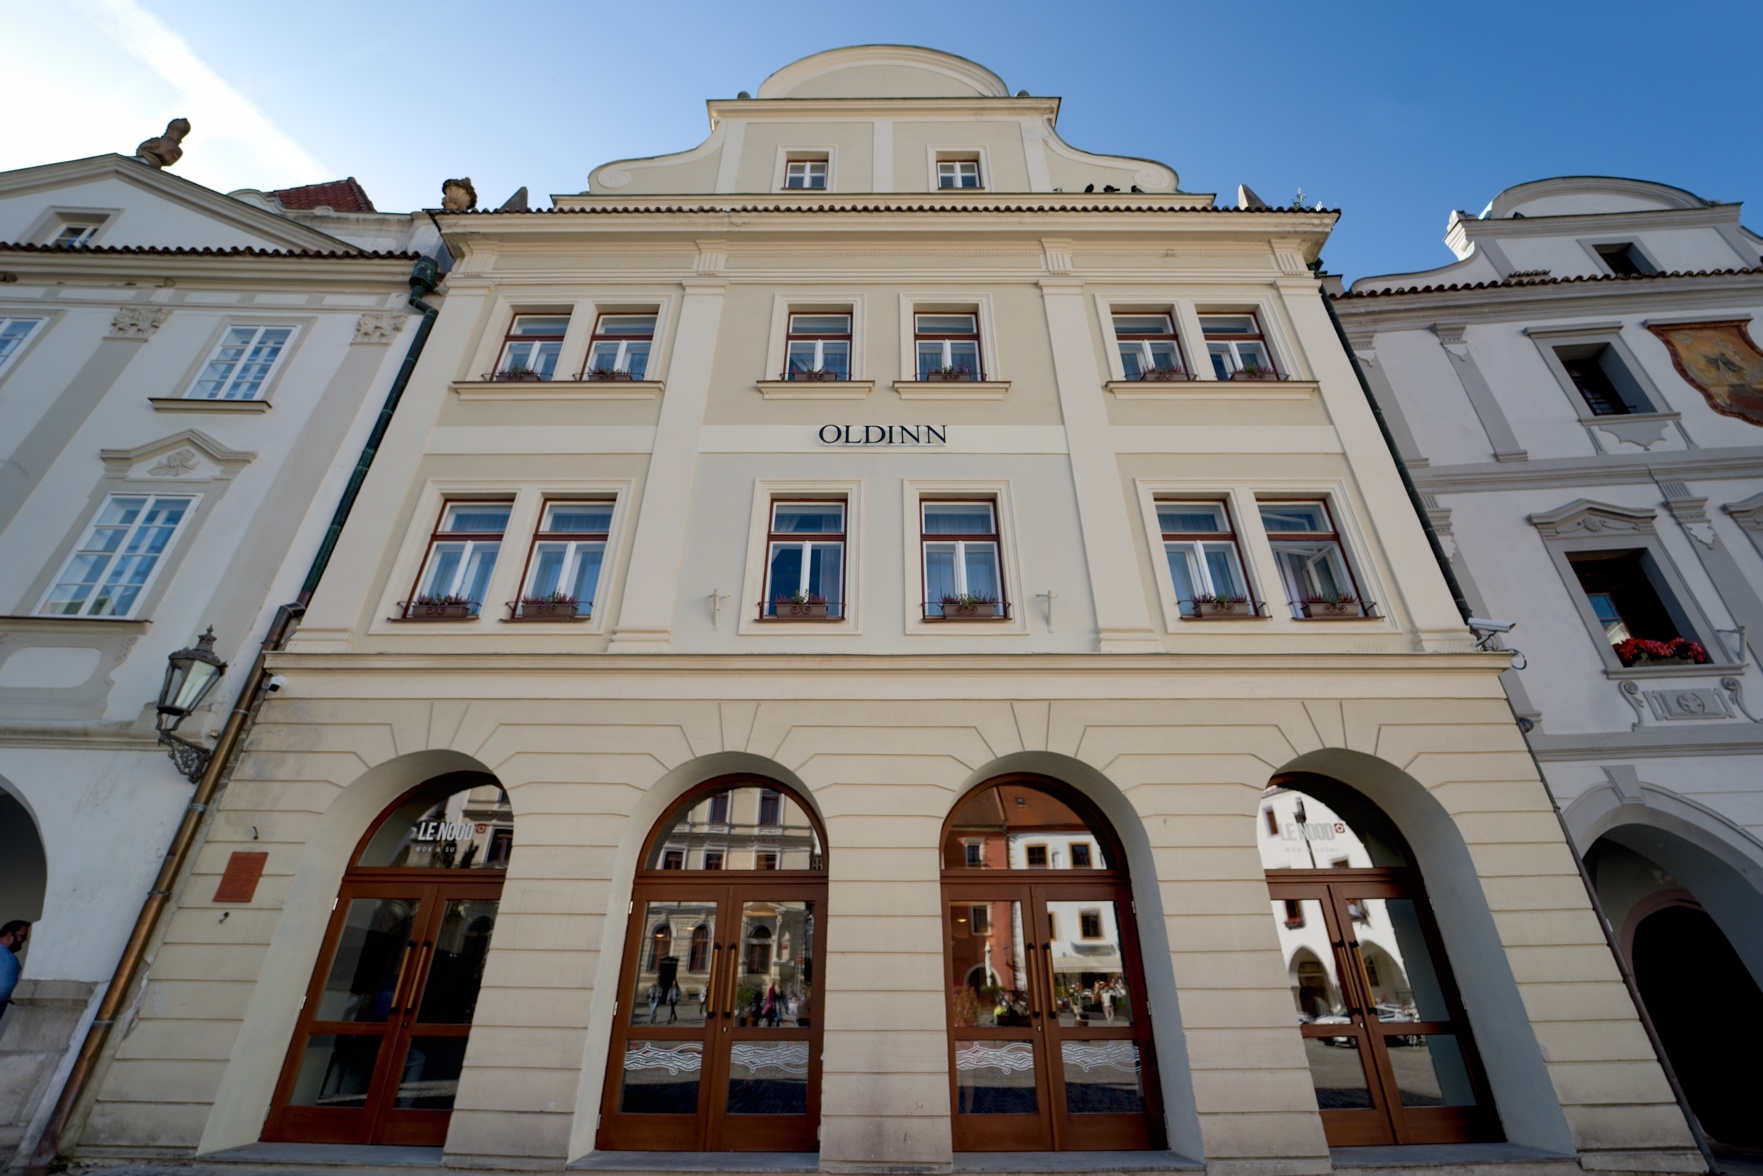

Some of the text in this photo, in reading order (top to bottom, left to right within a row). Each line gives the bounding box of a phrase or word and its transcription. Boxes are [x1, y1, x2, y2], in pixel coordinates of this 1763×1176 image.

[819, 424, 947, 444] OLDINN
[418, 822, 475, 841] LE NOOD
[1279, 823, 1297, 841] LE
